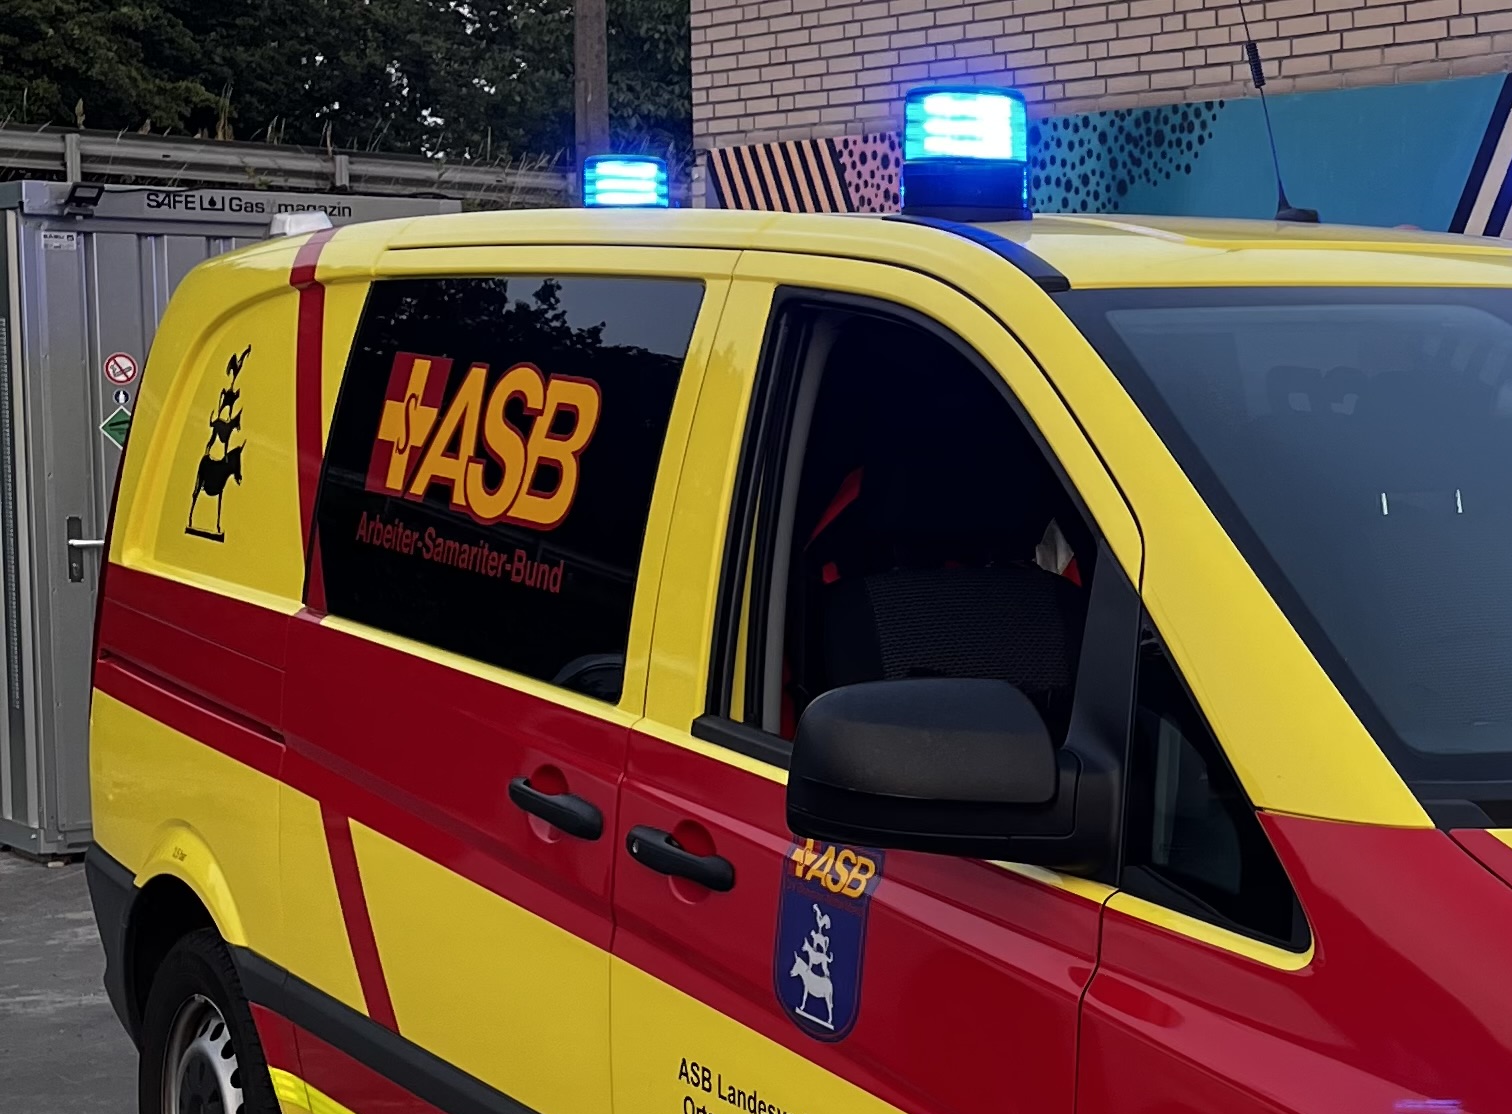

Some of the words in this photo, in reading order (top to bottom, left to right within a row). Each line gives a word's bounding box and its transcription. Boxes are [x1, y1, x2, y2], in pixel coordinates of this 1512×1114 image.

[146, 192, 197, 211] SAFE
[228, 196, 266, 214] Gas
[403, 362, 602, 531] ASB
[355, 511, 565, 593] Arbeiter-Samariter-Bund
[804, 845, 876, 899] ASB
[678, 1057, 713, 1093] ASB
